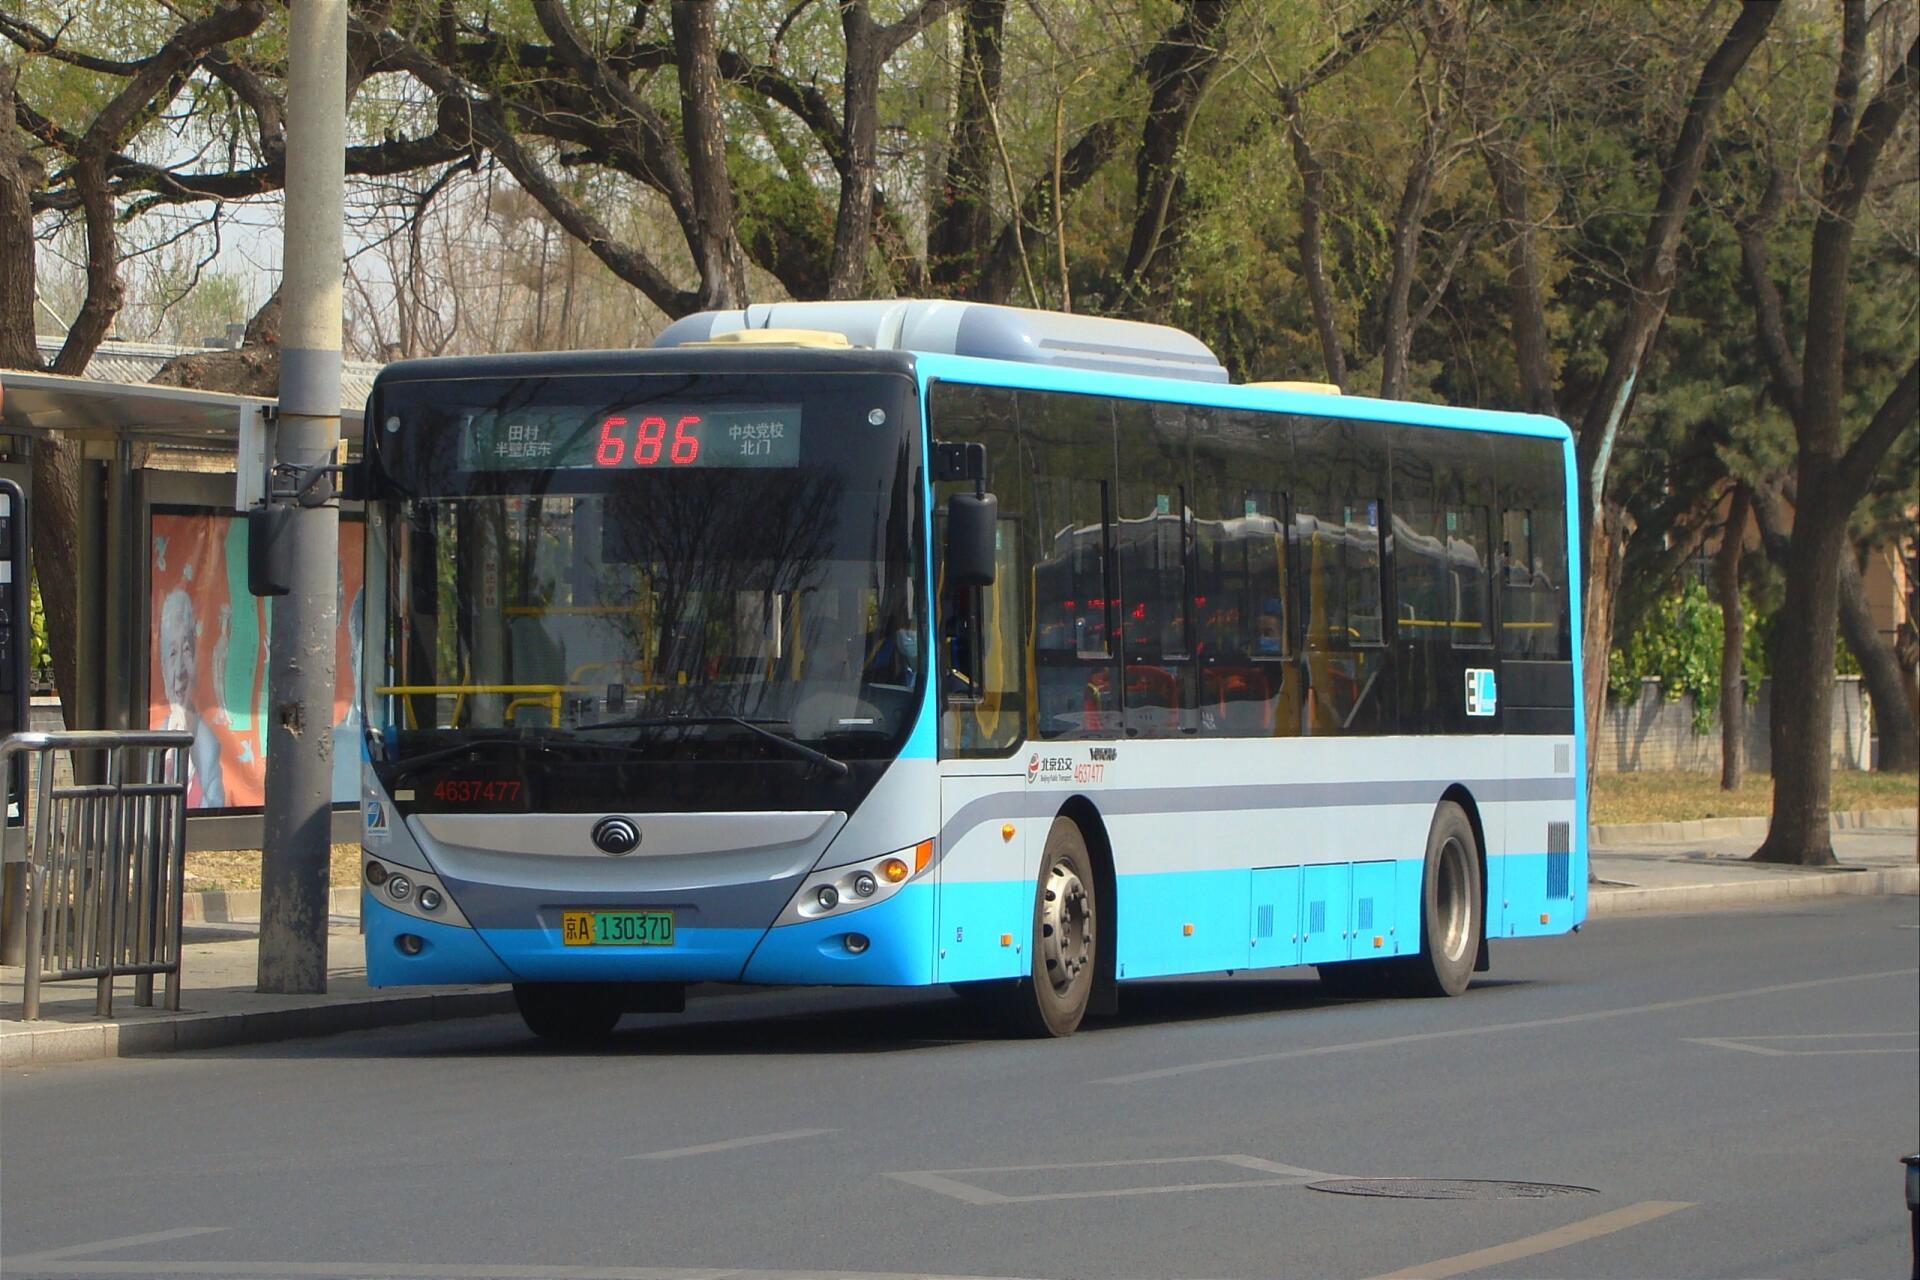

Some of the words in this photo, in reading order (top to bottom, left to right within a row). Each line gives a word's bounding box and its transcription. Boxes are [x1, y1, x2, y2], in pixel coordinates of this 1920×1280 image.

[508, 425, 539, 442] 田村
[729, 423, 784, 439] 中央党校
[596, 416, 701, 464] 686
[740, 439, 771, 455] 北门
[494, 442, 554, 457] 半壁店东
[1041, 757, 1073, 771] 北京公交
[1074, 764, 1104, 783] 4637477
[433, 780, 520, 801] 4637477
[566, 917, 589, 940] 京A
[601, 917, 671, 940] 13037D
